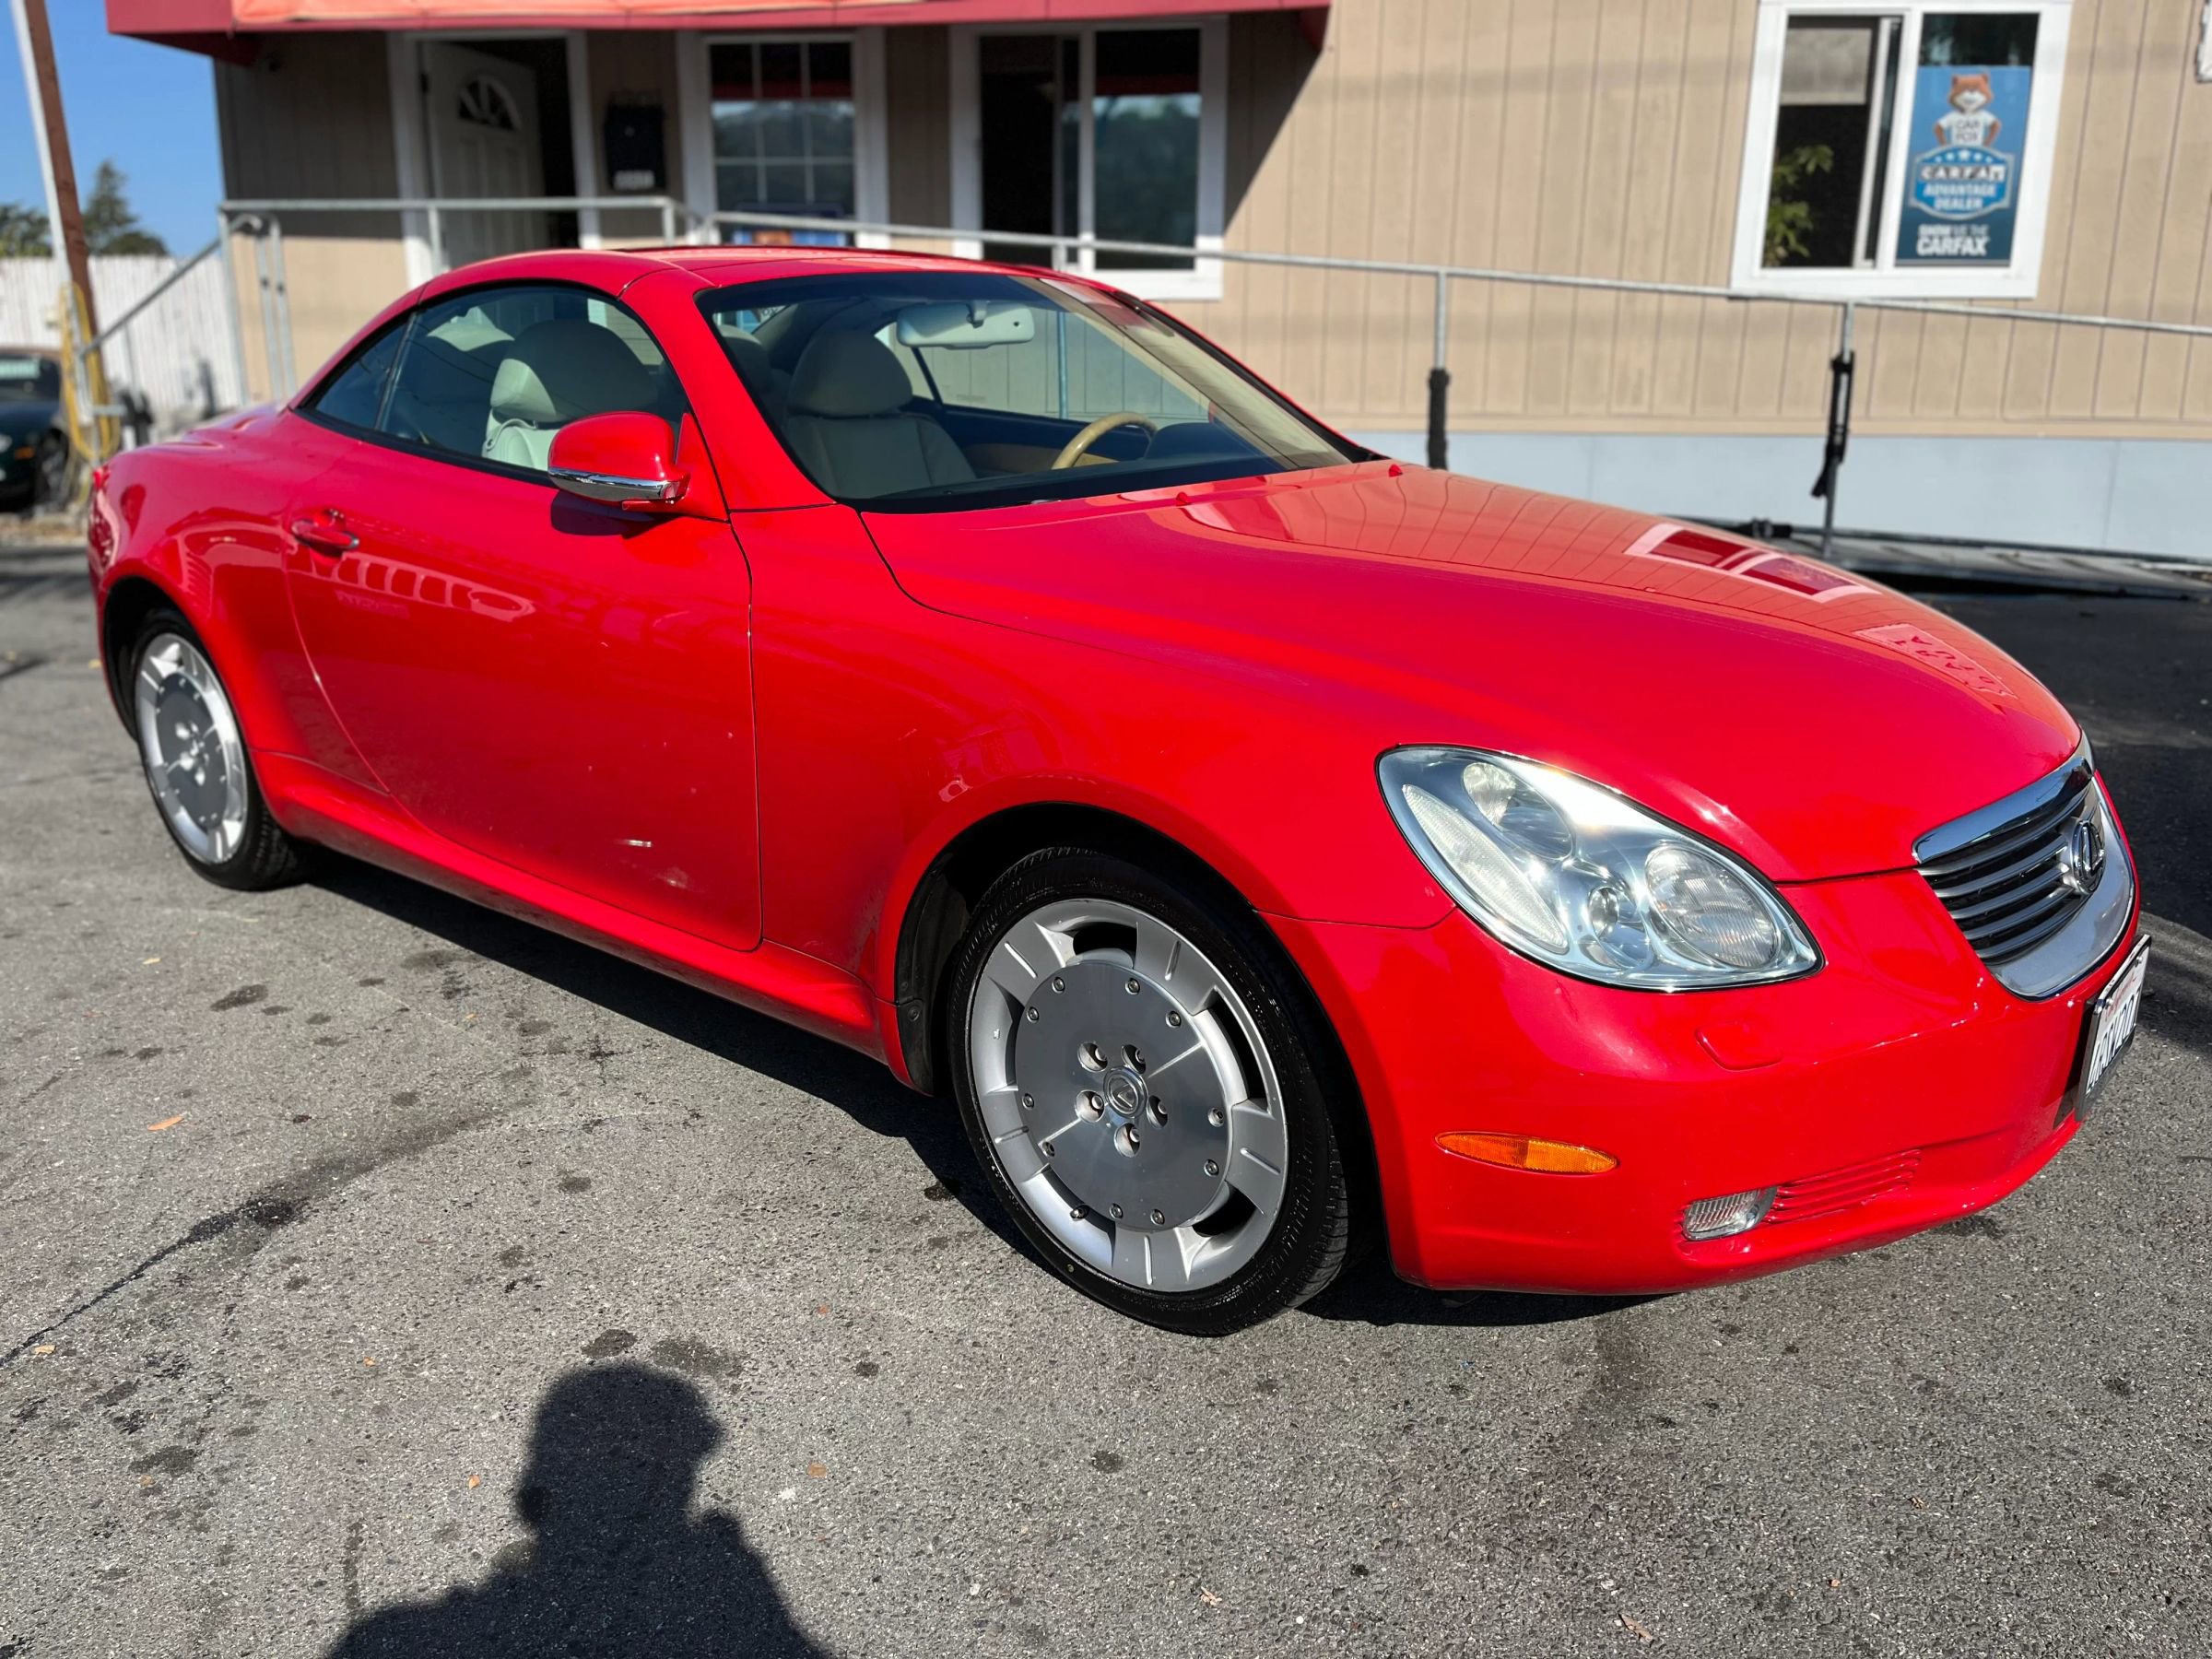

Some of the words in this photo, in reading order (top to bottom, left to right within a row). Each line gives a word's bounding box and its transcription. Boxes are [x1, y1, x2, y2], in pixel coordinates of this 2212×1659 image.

[1956, 120, 1980, 129] CAR
[1922, 166, 2006, 182] CARFAX
[1924, 183, 1995, 196] ADVANTAGE
[1935, 197, 1983, 210] DEALER
[1917, 237, 1989, 255] CARFAX
